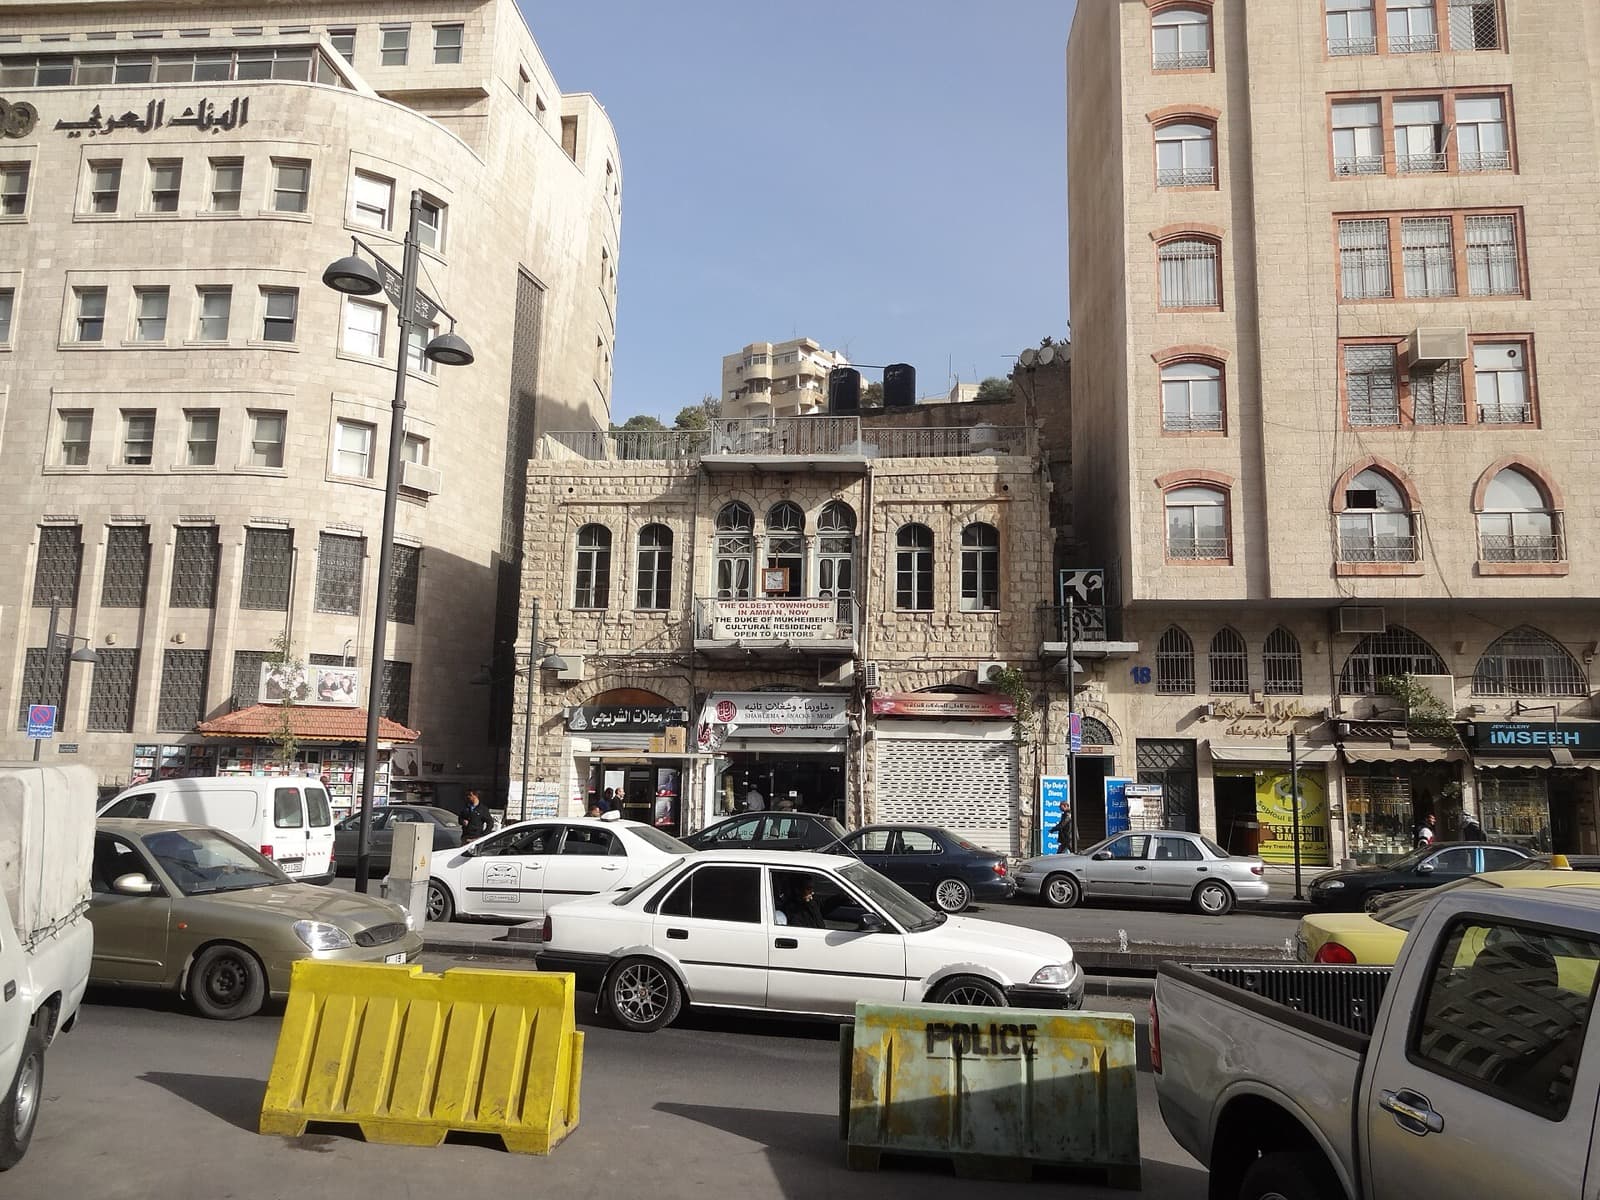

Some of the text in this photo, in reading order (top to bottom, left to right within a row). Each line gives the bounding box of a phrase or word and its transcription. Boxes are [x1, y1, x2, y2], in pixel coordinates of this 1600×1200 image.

[53, 96, 249, 138] البنك العربي
[1130, 666, 1152, 685] 18
[632, 708, 663, 724] محلات
[765, 702, 797, 713] وشغلات
[804, 702, 830, 713] شاورما
[926, 1023, 1039, 1055] POLICE
